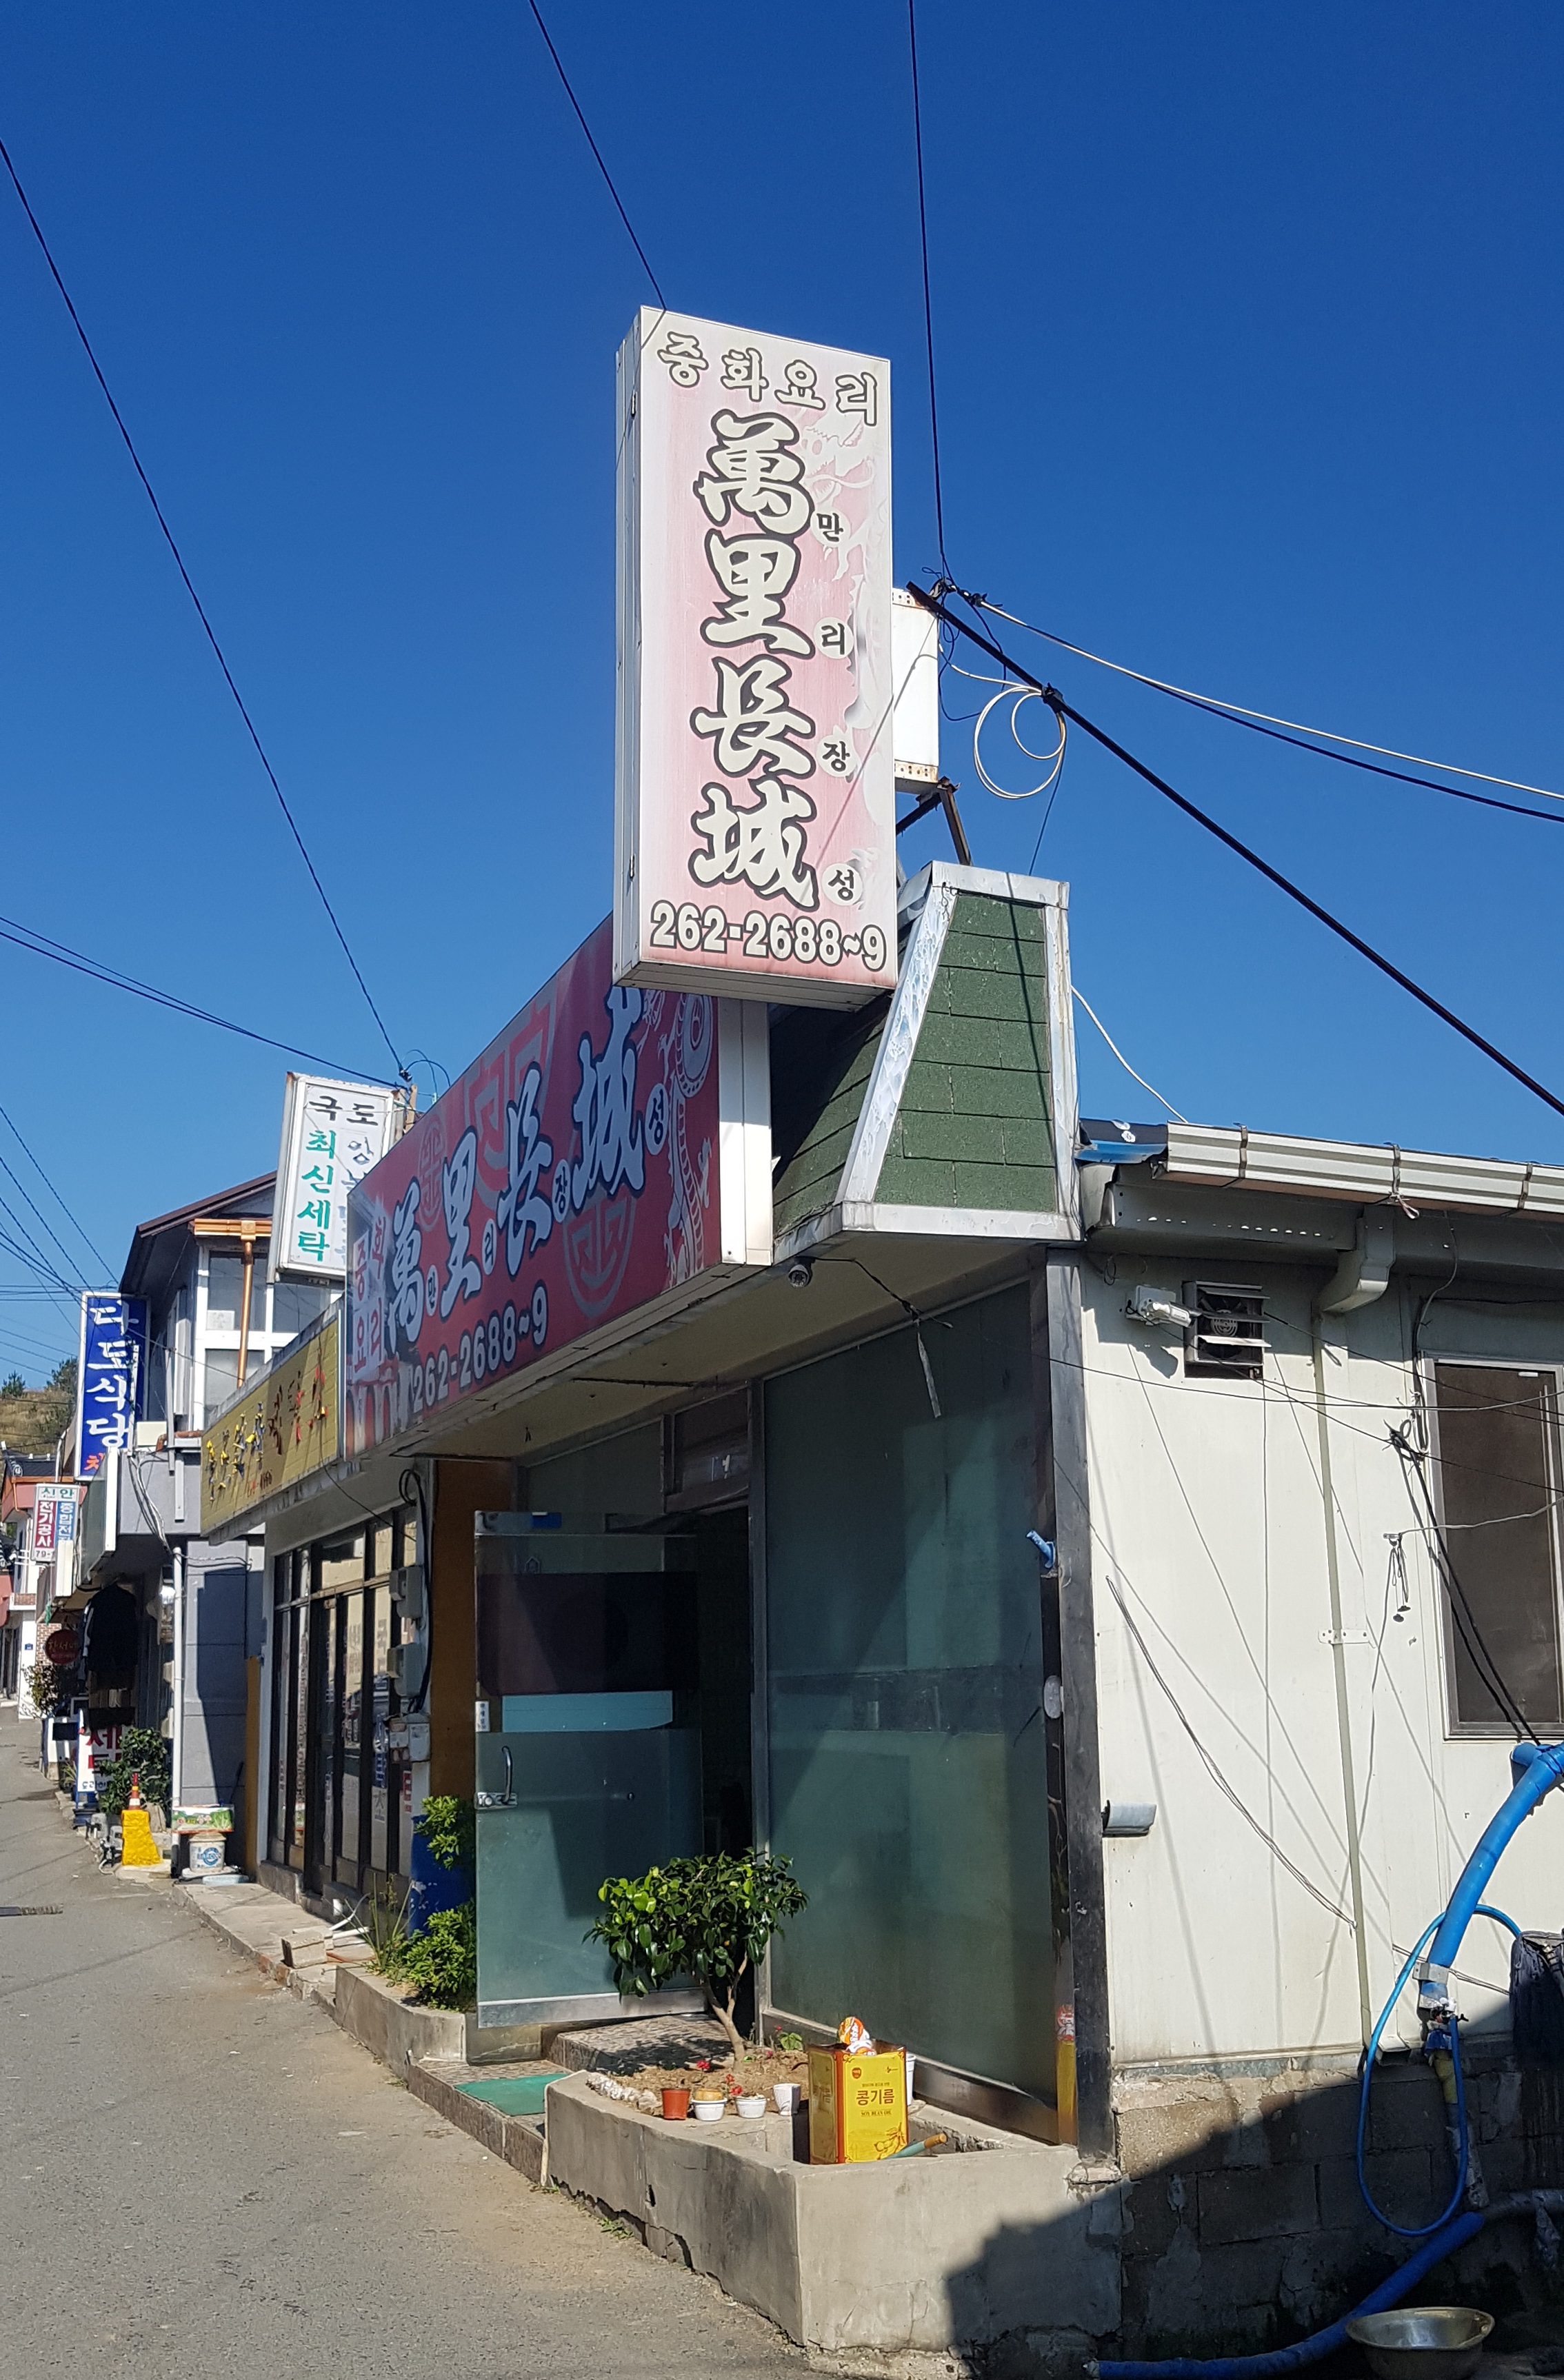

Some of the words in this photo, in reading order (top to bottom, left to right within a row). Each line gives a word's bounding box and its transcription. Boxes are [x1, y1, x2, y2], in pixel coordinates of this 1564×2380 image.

[657, 330, 877, 427] 중화요리
[688, 408, 821, 912] 萬里長城
[650, 899, 888, 972] 262-2688~9
[308, 1096, 379, 1127] 국도
[297, 1129, 337, 1262] 최신세탁
[37, 1501, 54, 1547] 전기공사
[856, 2088, 895, 2106] 콩기름
